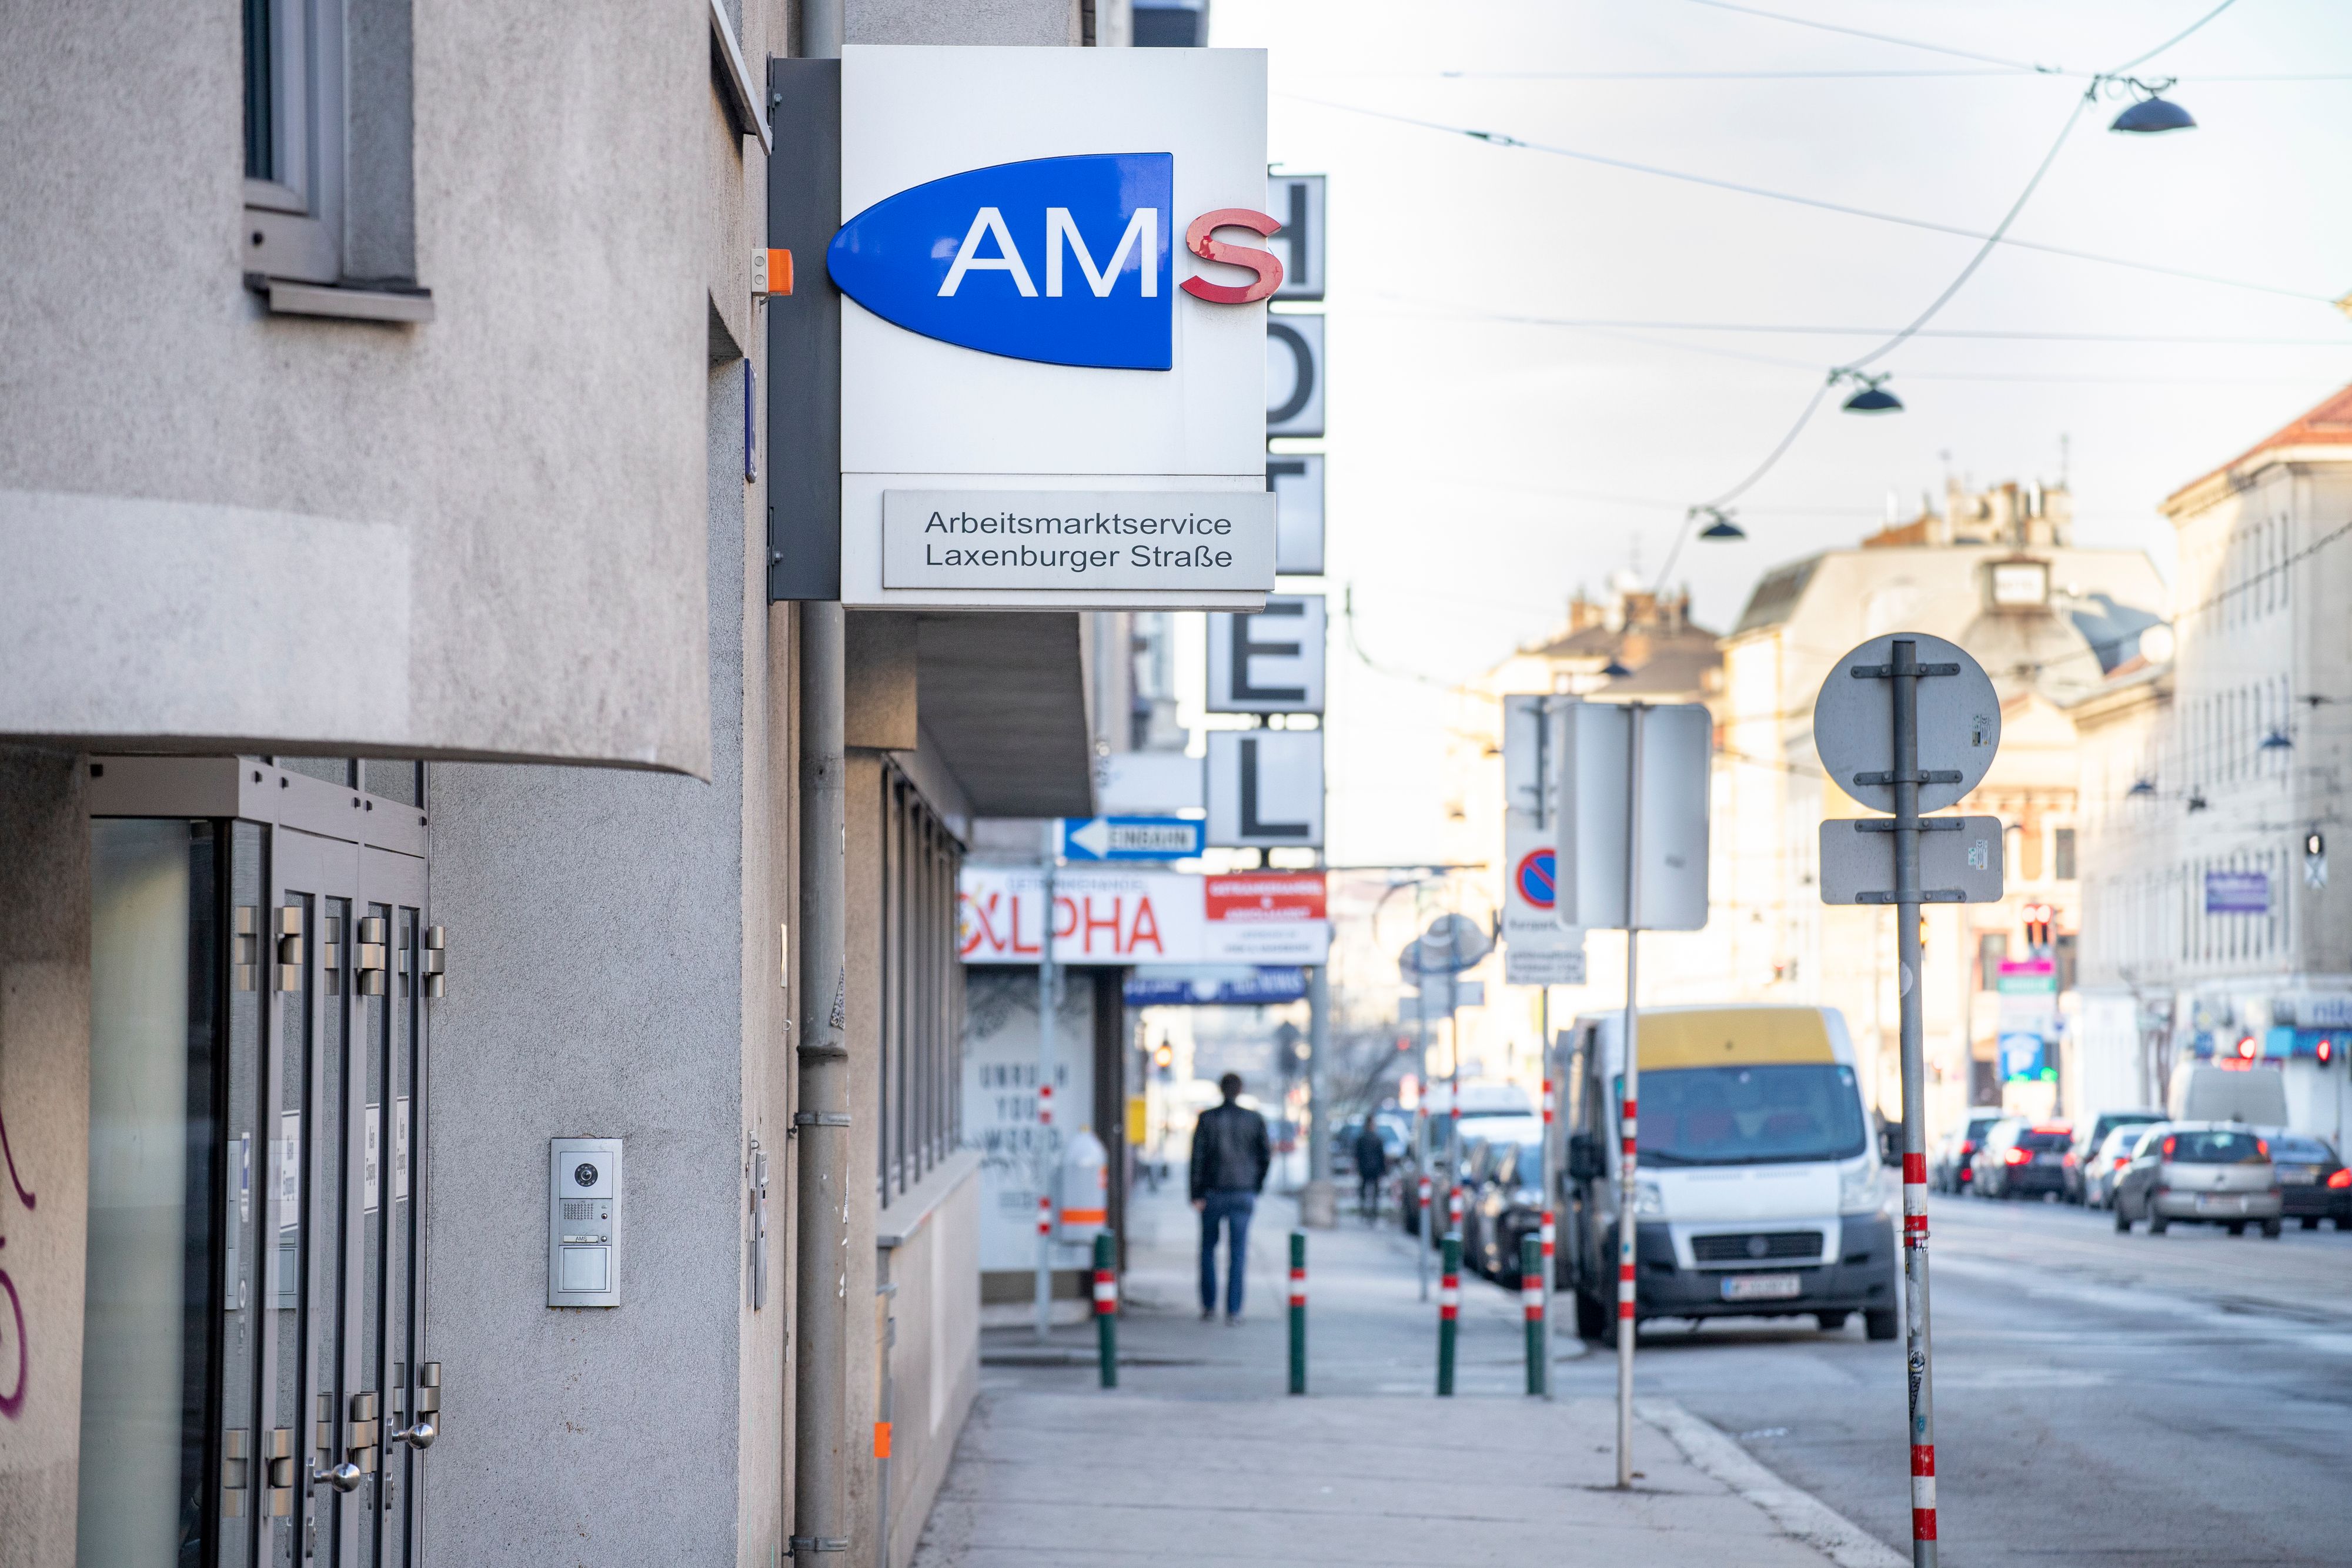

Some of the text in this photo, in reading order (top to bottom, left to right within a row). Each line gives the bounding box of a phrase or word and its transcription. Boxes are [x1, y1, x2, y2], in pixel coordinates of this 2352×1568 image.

[937, 206, 1284, 305] AMS
[924, 511, 1231, 535] Arbeitsmarktservice
[927, 544, 1232, 573] Laxenburger Straße
